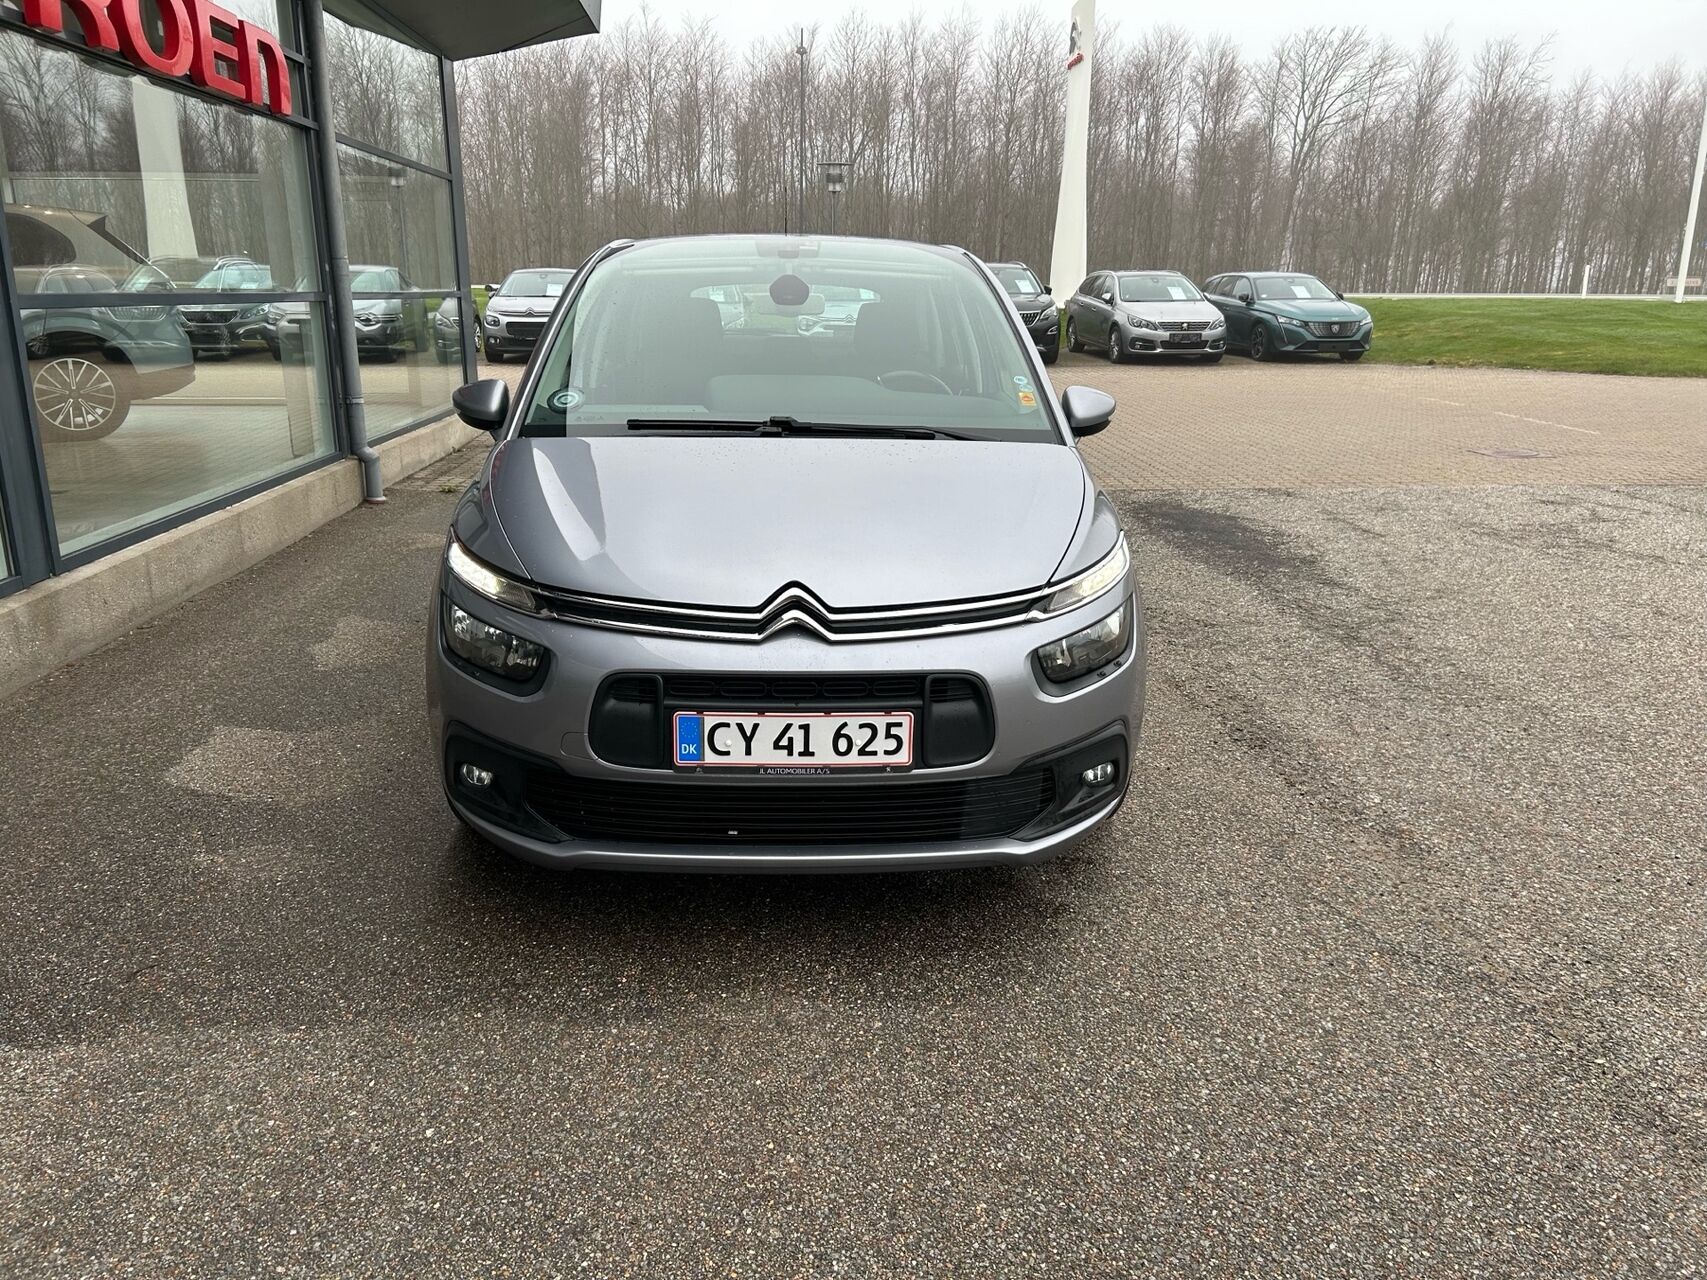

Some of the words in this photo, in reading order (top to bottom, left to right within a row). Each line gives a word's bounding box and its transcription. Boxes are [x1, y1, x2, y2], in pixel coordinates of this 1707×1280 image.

[681, 744, 697, 754] DK
[706, 722, 760, 756] CY
[773, 722, 815, 757] 41
[832, 721, 904, 757] 625
